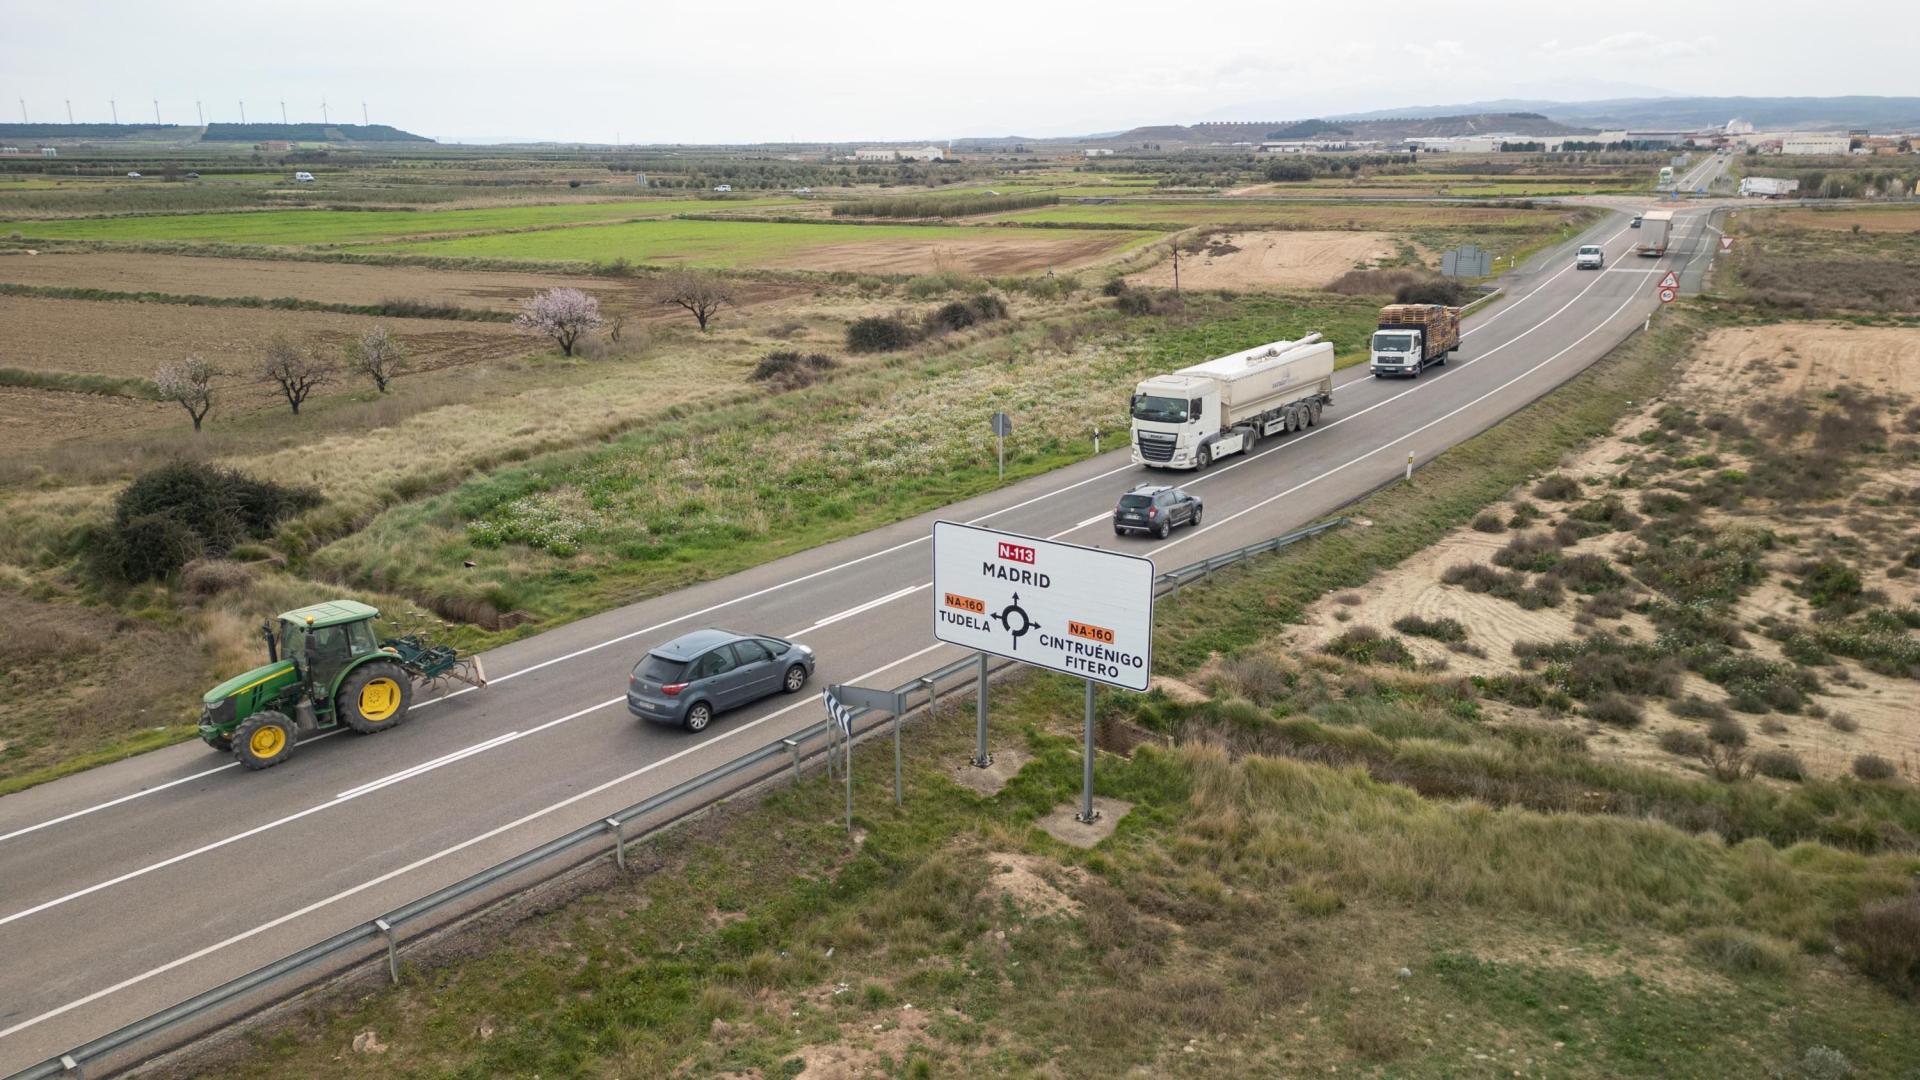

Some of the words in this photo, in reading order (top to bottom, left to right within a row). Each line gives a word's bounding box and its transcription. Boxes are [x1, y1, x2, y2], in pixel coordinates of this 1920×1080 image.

[1000, 544, 1034, 562] N-113
[983, 562, 1051, 589] MADRID
[946, 596, 983, 611] NA-160
[939, 610, 991, 632] TUDELA
[1070, 624, 1112, 641] NA-160
[1039, 634, 1143, 668] CINTRUÉNIGO
[1066, 656, 1119, 678] FITERO
